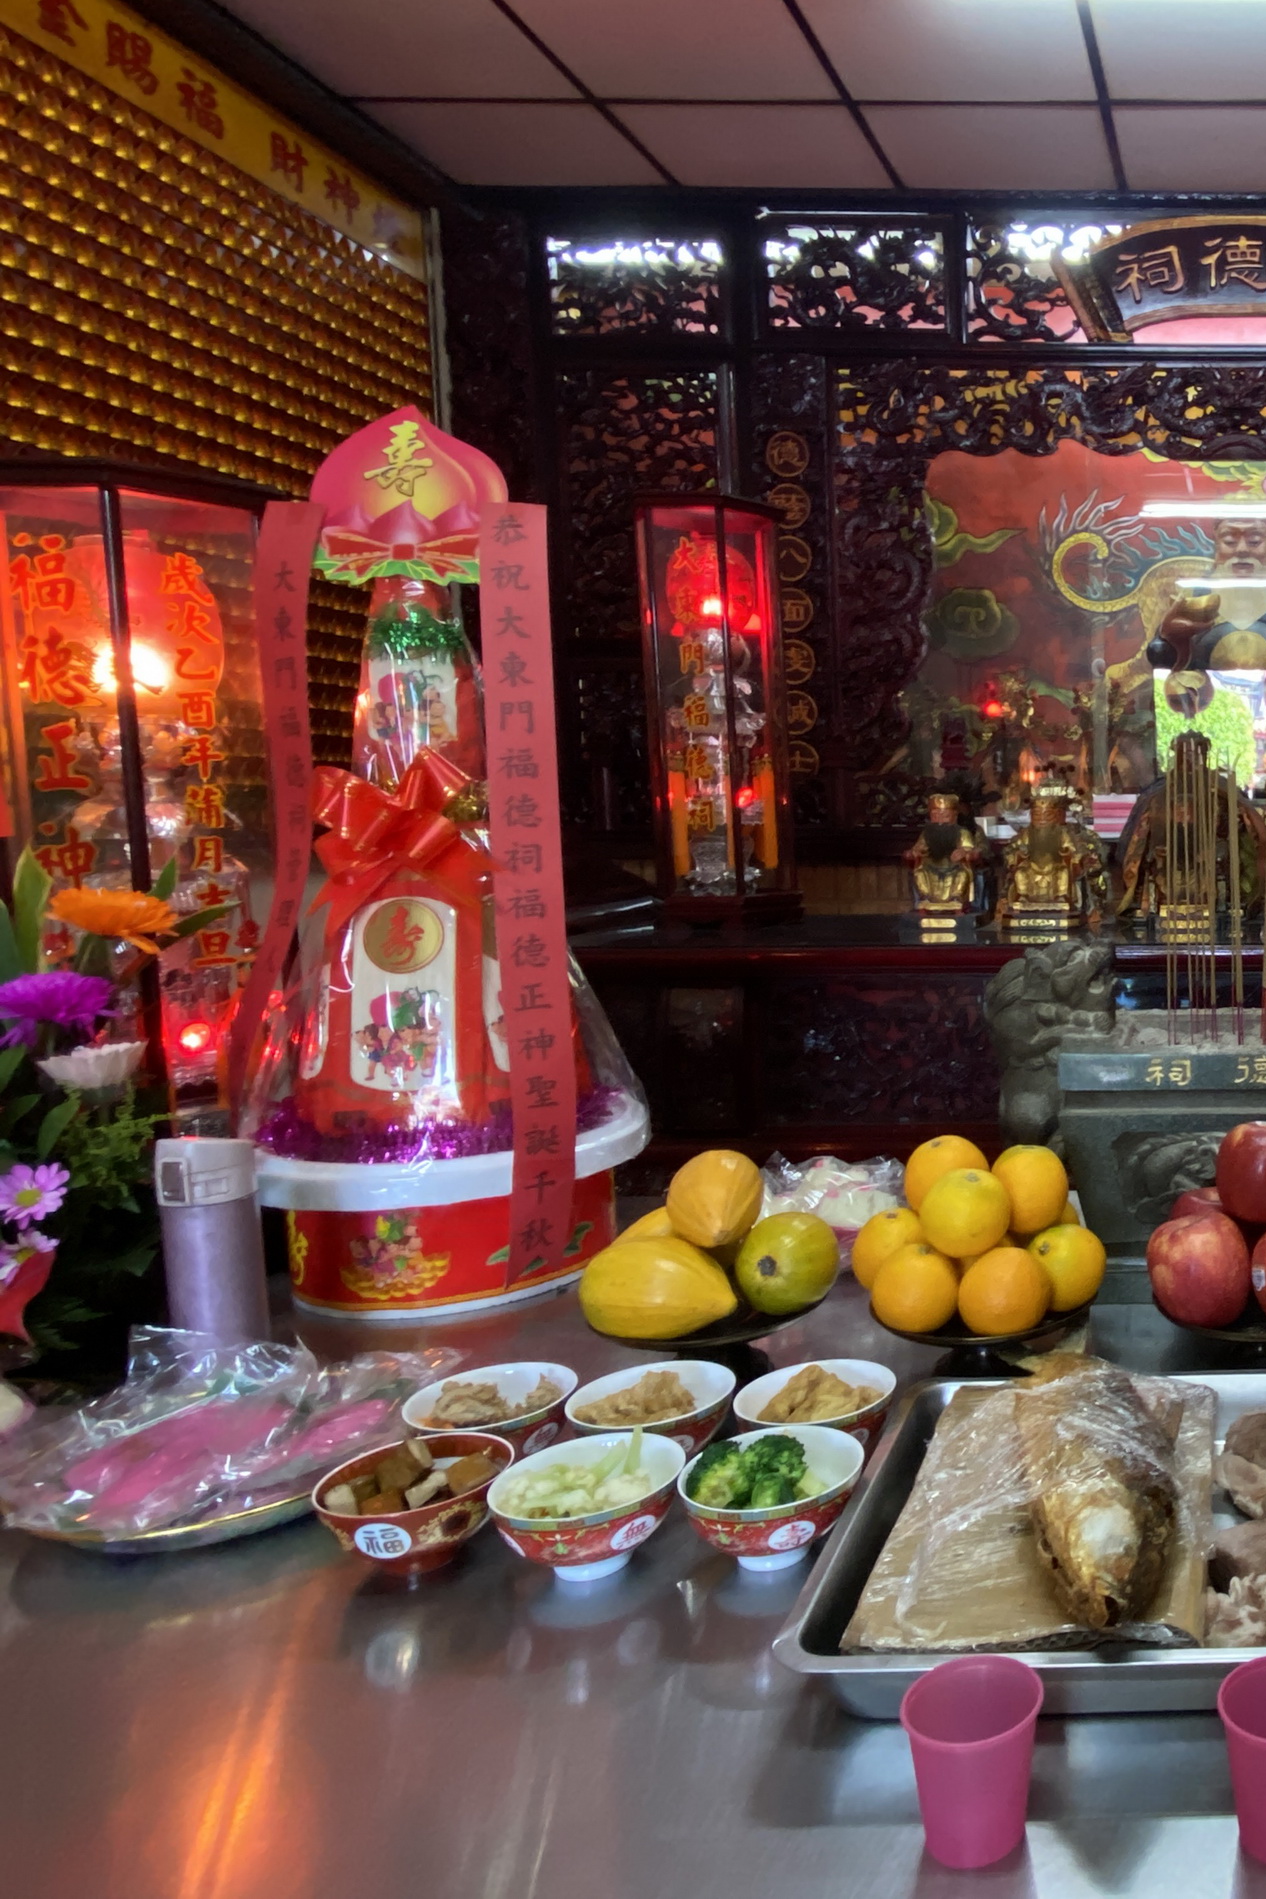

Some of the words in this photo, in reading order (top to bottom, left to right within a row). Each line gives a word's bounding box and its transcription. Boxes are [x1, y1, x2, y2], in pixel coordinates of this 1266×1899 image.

[9, 531, 100, 889] 福德正神
[490, 513, 560, 1250] 恭祝大東門福德祠福德正神聖誕千秋
[361, 1526, 406, 1555] 福
